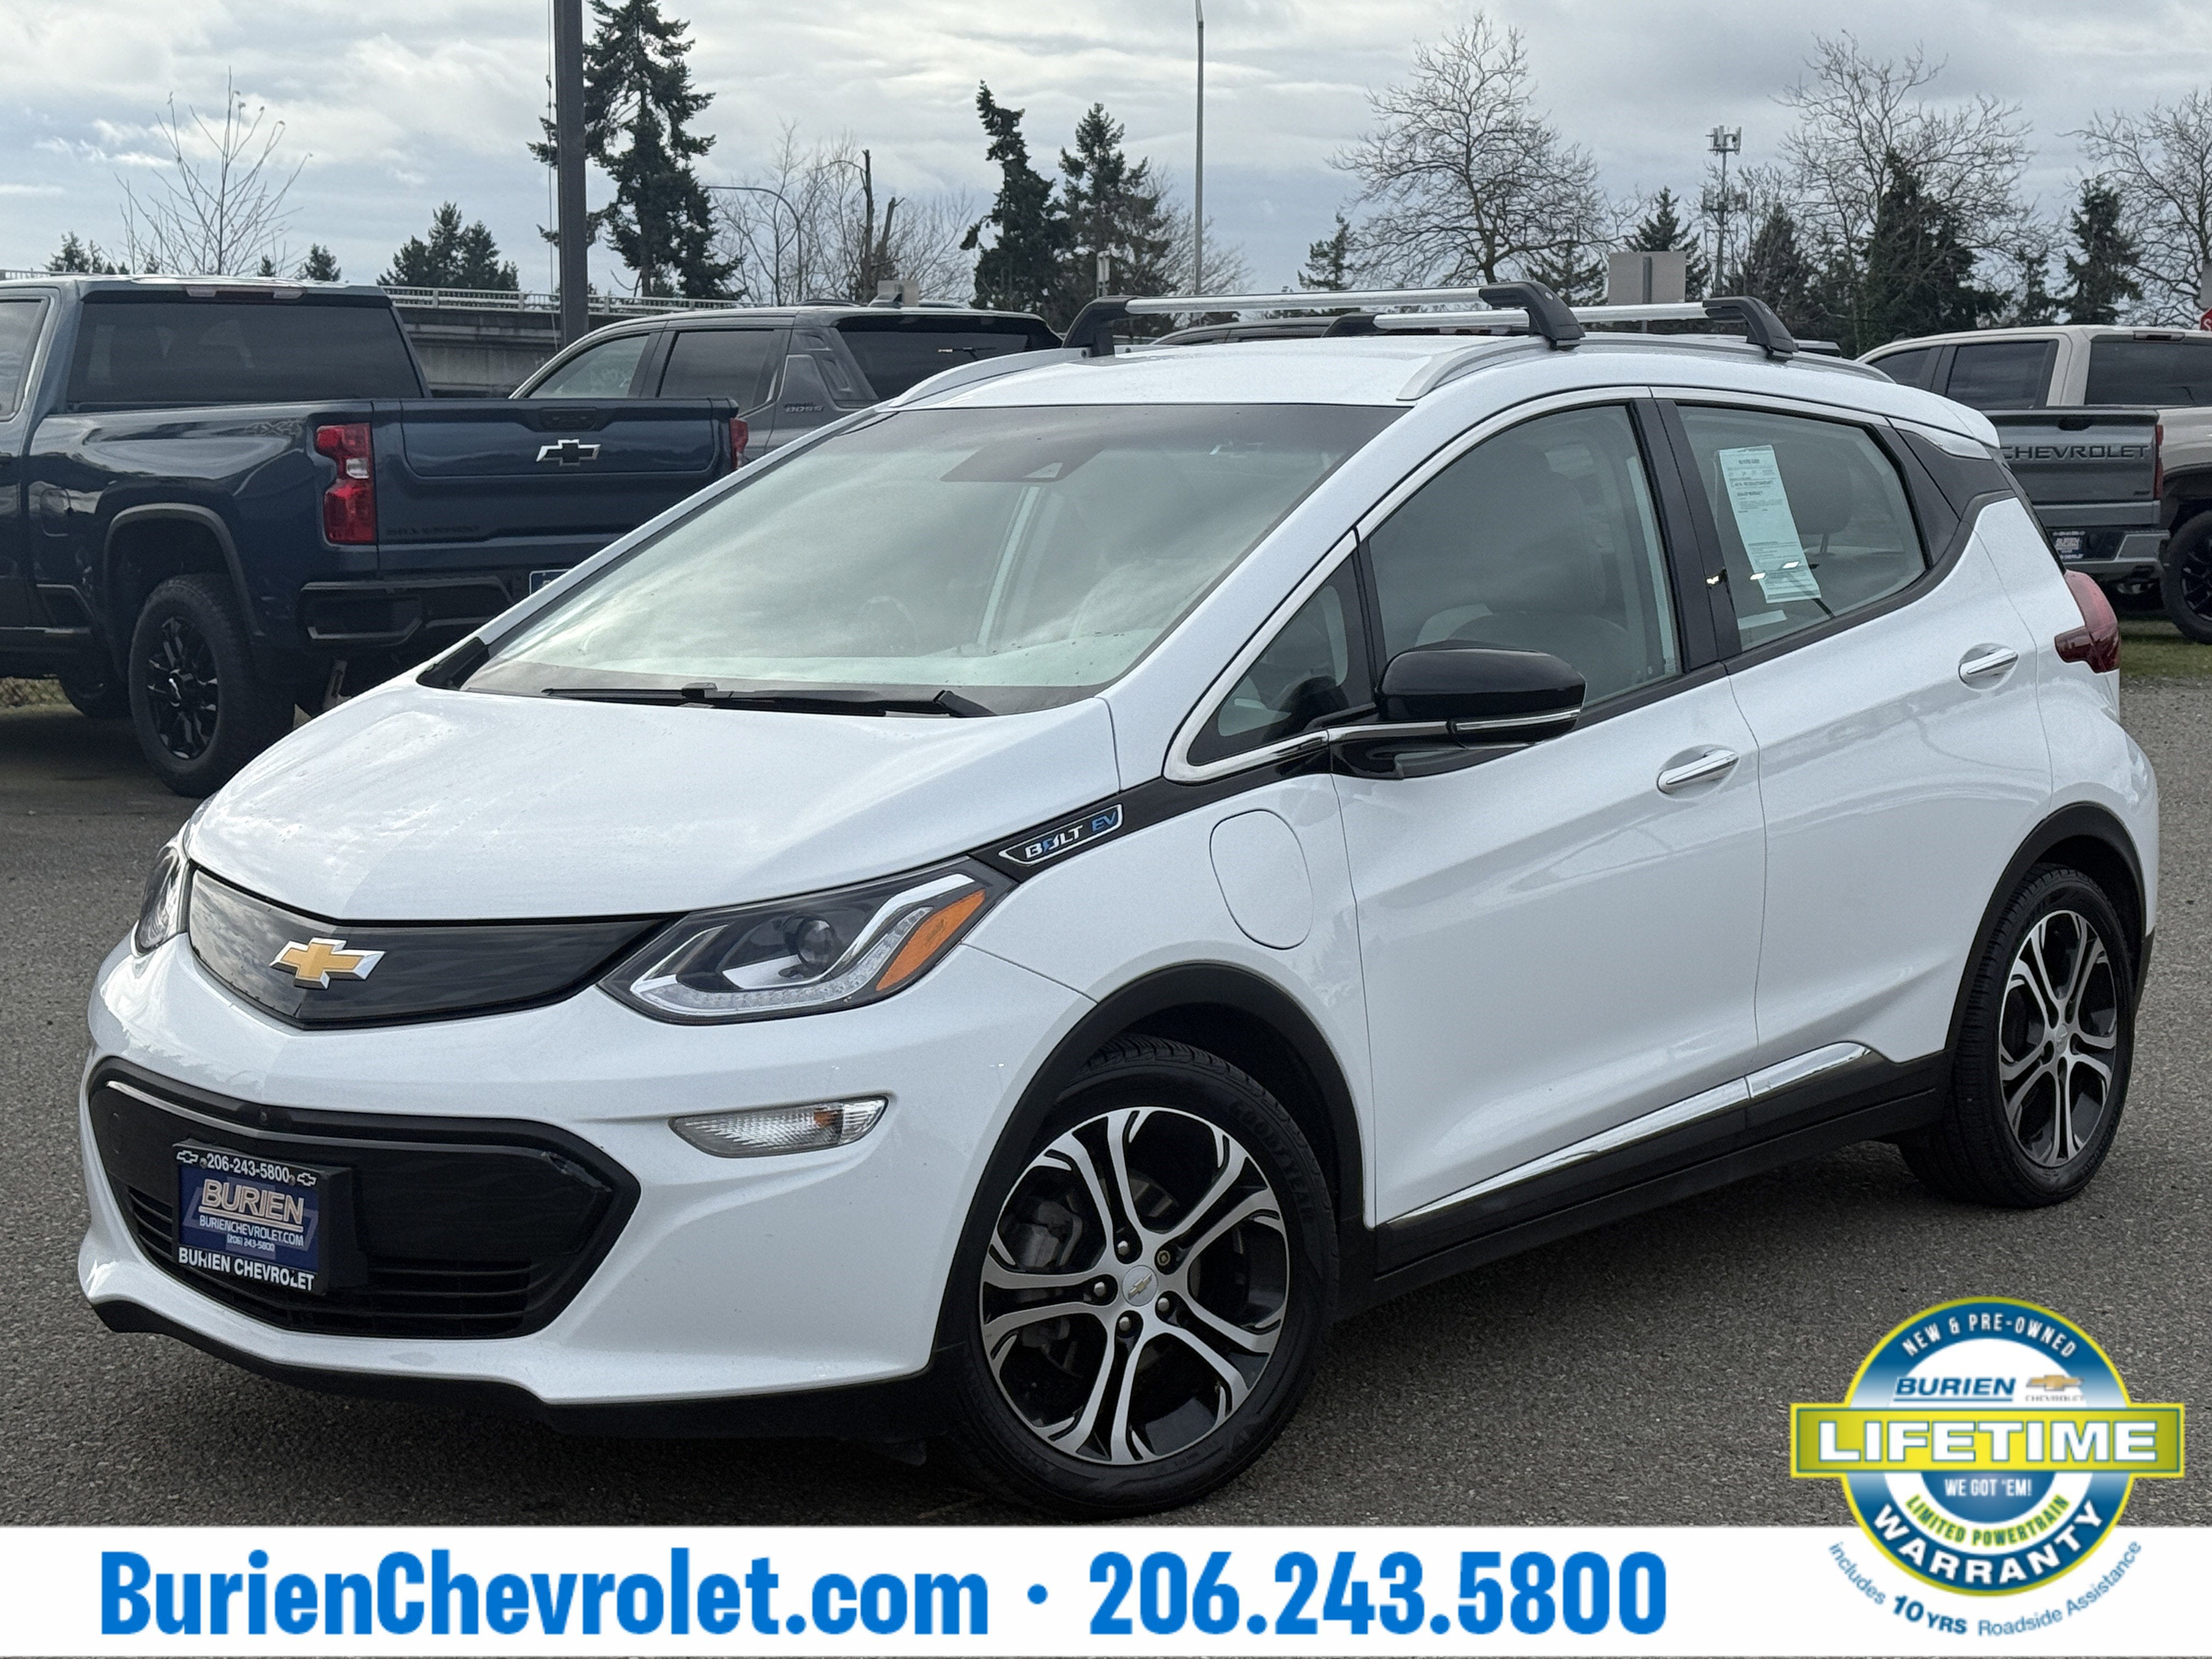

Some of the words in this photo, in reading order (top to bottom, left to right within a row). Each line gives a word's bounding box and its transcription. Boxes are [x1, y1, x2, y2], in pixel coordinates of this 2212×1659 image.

[2000, 445, 2149, 459] CHEVROLET
[1025, 825, 1083, 859] BOLT
[1091, 811, 1117, 833] EV
[207, 1153, 290, 1183] 206-243-5800
[202, 1178, 304, 1224] BURIEN
[199, 1215, 304, 1247] BURIENCHEVROLET.COM
[244, 1235, 275, 1252] 243-5800
[178, 1247, 230, 1273] BURIEN
